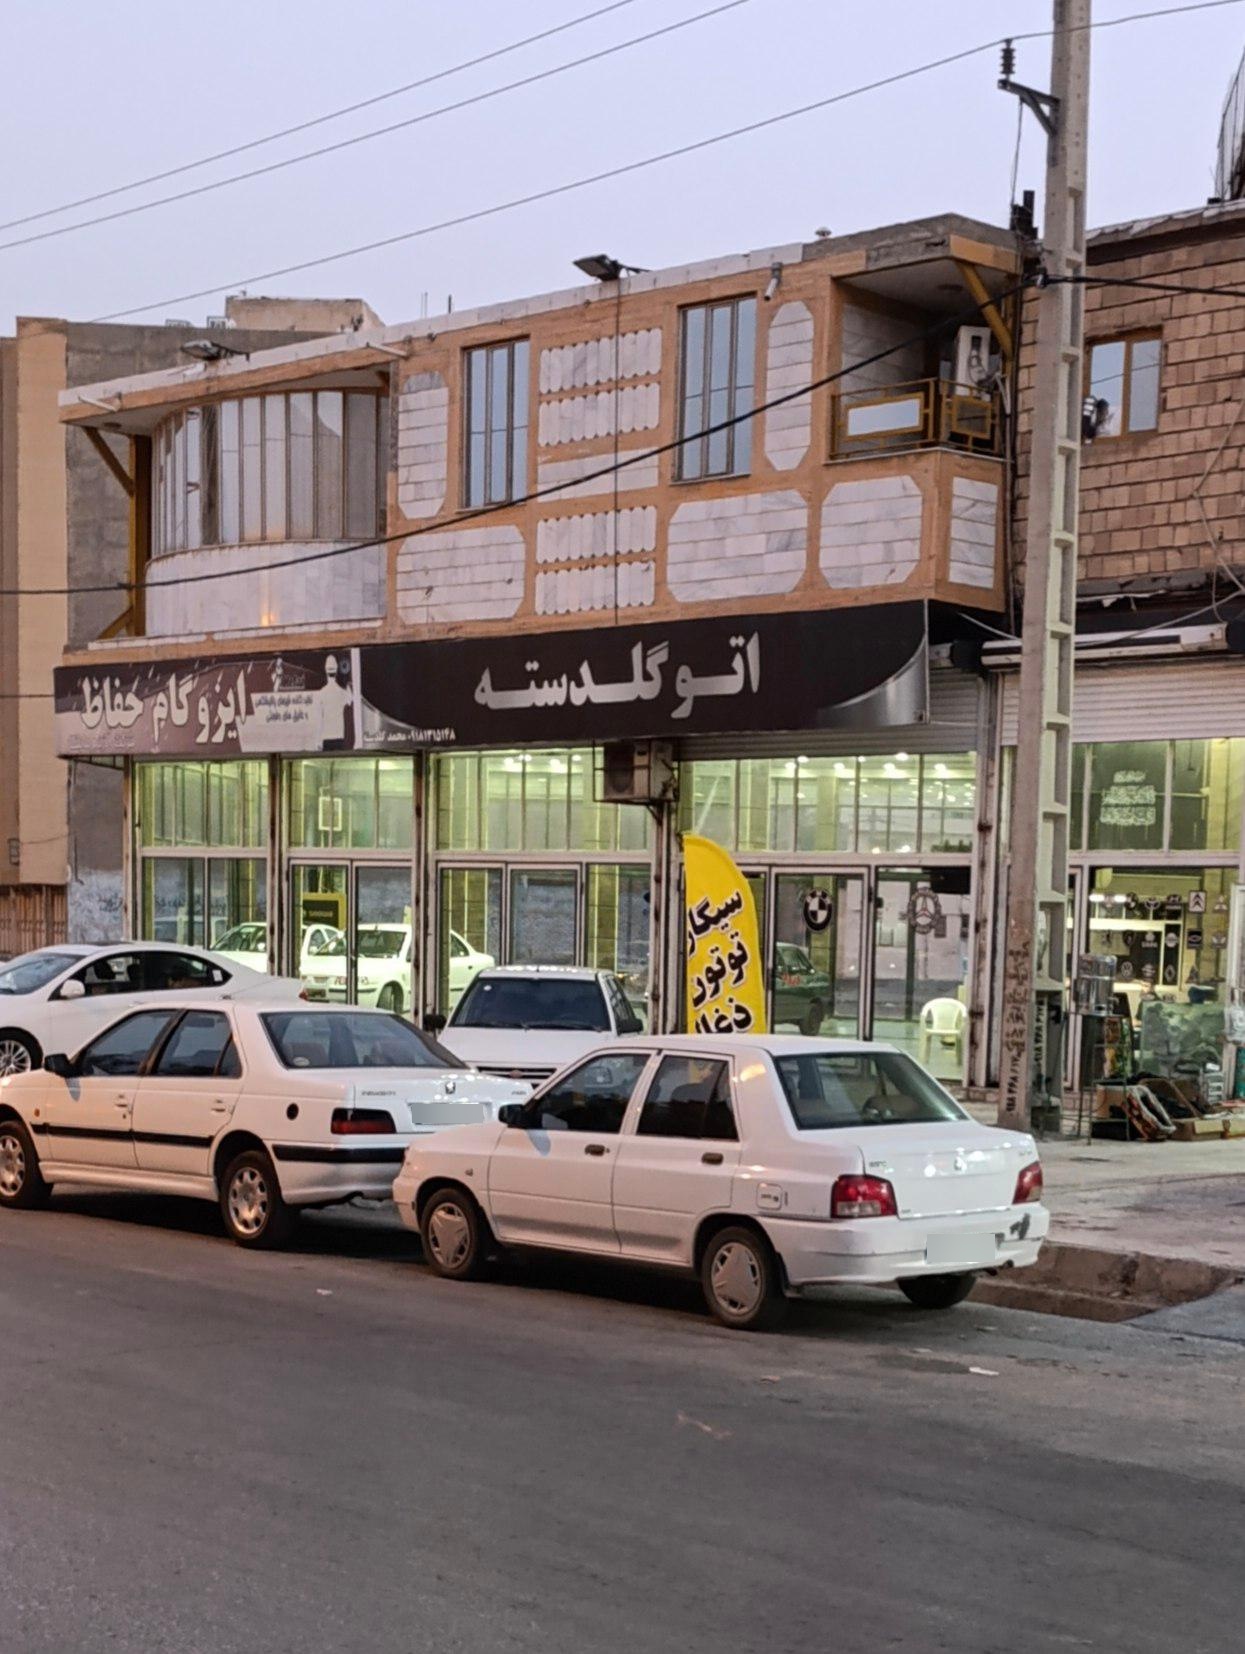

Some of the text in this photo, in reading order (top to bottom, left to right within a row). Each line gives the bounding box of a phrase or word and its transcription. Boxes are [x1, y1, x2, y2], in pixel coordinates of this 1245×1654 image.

[80, 675, 144, 729] حفاظ
[473, 632, 761, 719] اتو گلدسته
